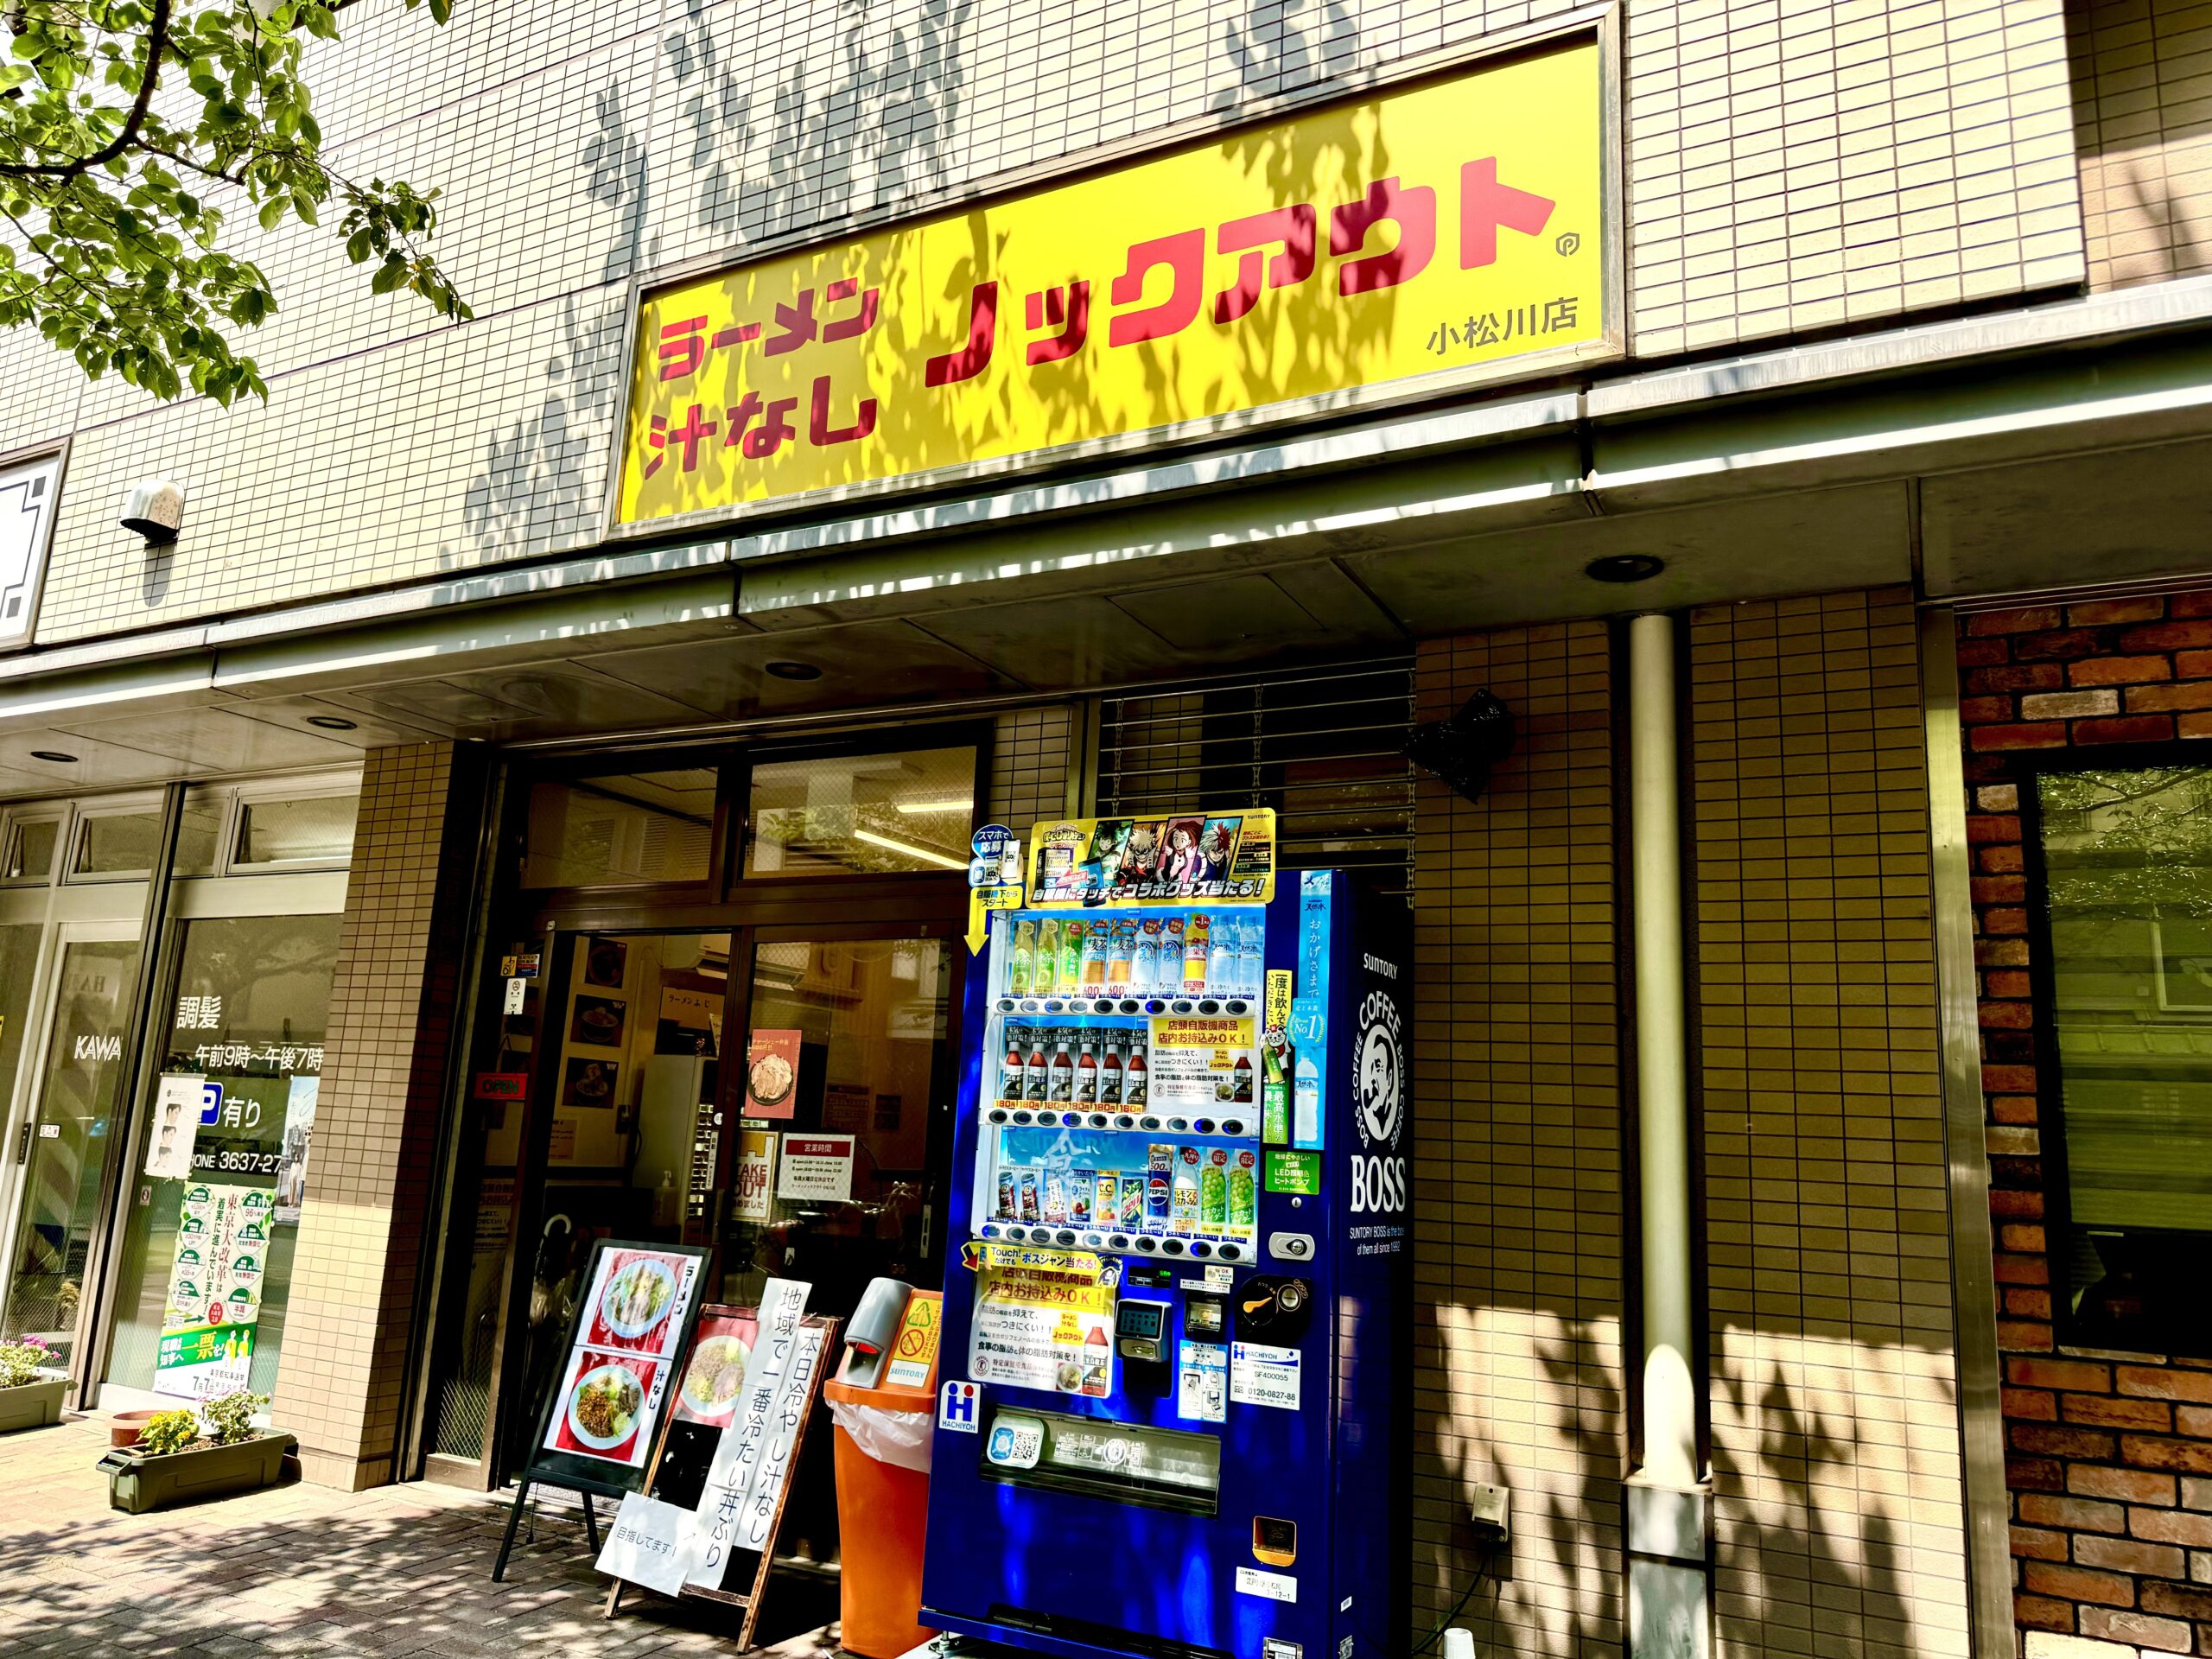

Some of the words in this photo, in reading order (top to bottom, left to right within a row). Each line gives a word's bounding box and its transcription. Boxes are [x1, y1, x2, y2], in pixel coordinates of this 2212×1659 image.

[925, 156, 1556, 389] ノックアウト
[658, 276, 880, 382] ラーメン
[1427, 296, 1579, 356] 小松川店
[645, 375, 878, 480] 汁なし
[978, 830, 1009, 841] スマホで
[980, 841, 1002, 854] 応募
[976, 890, 1018, 899] 自販機下から
[982, 899, 1008, 907] スタート
[1304, 903, 1326, 912] 天然水
[1091, 938, 1107, 951] 麦茶
[1118, 938, 1134, 951] 麦茶
[1307, 919, 1321, 999] おかげさまで
[1363, 952, 1398, 979] SUNTORY
[1274, 974, 1287, 1024] 一度は飲んで
[176, 995, 222, 1030] 調髪
[1359, 991, 1402, 1040] COFFEE
[1168, 1020, 1238, 1031] 店頭自販機商品
[1353, 1032, 1363, 1101] COFFEE
[482, 1079, 520, 1094] OPEN
[1019, 1100, 1040, 1109] 180円
[1044, 1101, 1065, 1109] 180円
[1068, 1102, 1090, 1110] 180円
[1119, 1104, 1142, 1113] 180円
[223, 1096, 261, 1128] 有り
[1274, 1090, 1285, 1141] 最高水準の
[1355, 1106, 1369, 1149] BOSS
[1390, 1094, 1405, 1152] COFFEE
[804, 1143, 832, 1154] 営業時間
[734, 1163, 768, 1177] TAKE
[1274, 1177, 1310, 1186] ヒートポンプ
[1350, 1154, 1406, 1213] BOSS
[1350, 1227, 1373, 1239] SUNTORY
[1374, 1226, 1386, 1237] BOSS
[216, 1193, 239, 1294] 東京大改革は
[1357, 1243, 1363, 1255] of
[1363, 1243, 1373, 1255] them
[1379, 1242, 1389, 1253] since
[1390, 1241, 1401, 1252] 1992
[202, 1198, 226, 1315] 着実に進んでいます!
[991, 1247, 1021, 1258] Touch!
[1022, 1252, 1097, 1269] ボスジャン当たる!
[674, 1266, 695, 1315] ラーメン
[1052, 1332, 1084, 1342] ノックアウト
[1246, 1351, 1278, 1360] HACHIYOH
[890, 1367, 925, 1379] SUNTORY
[1255, 1371, 1288, 1382] SF400055
[649, 1370, 665, 1409] 汁なし
[1249, 1388, 1296, 1401] 0120-0827-88
[707, 1286, 802, 1569] 地域で一番冷たい丼ぶり
[942, 1421, 976, 1431] HACHIYOH
[748, 1332, 822, 1545] 本日冷やし汁なし
[616, 1525, 677, 1557] 目指してます!
